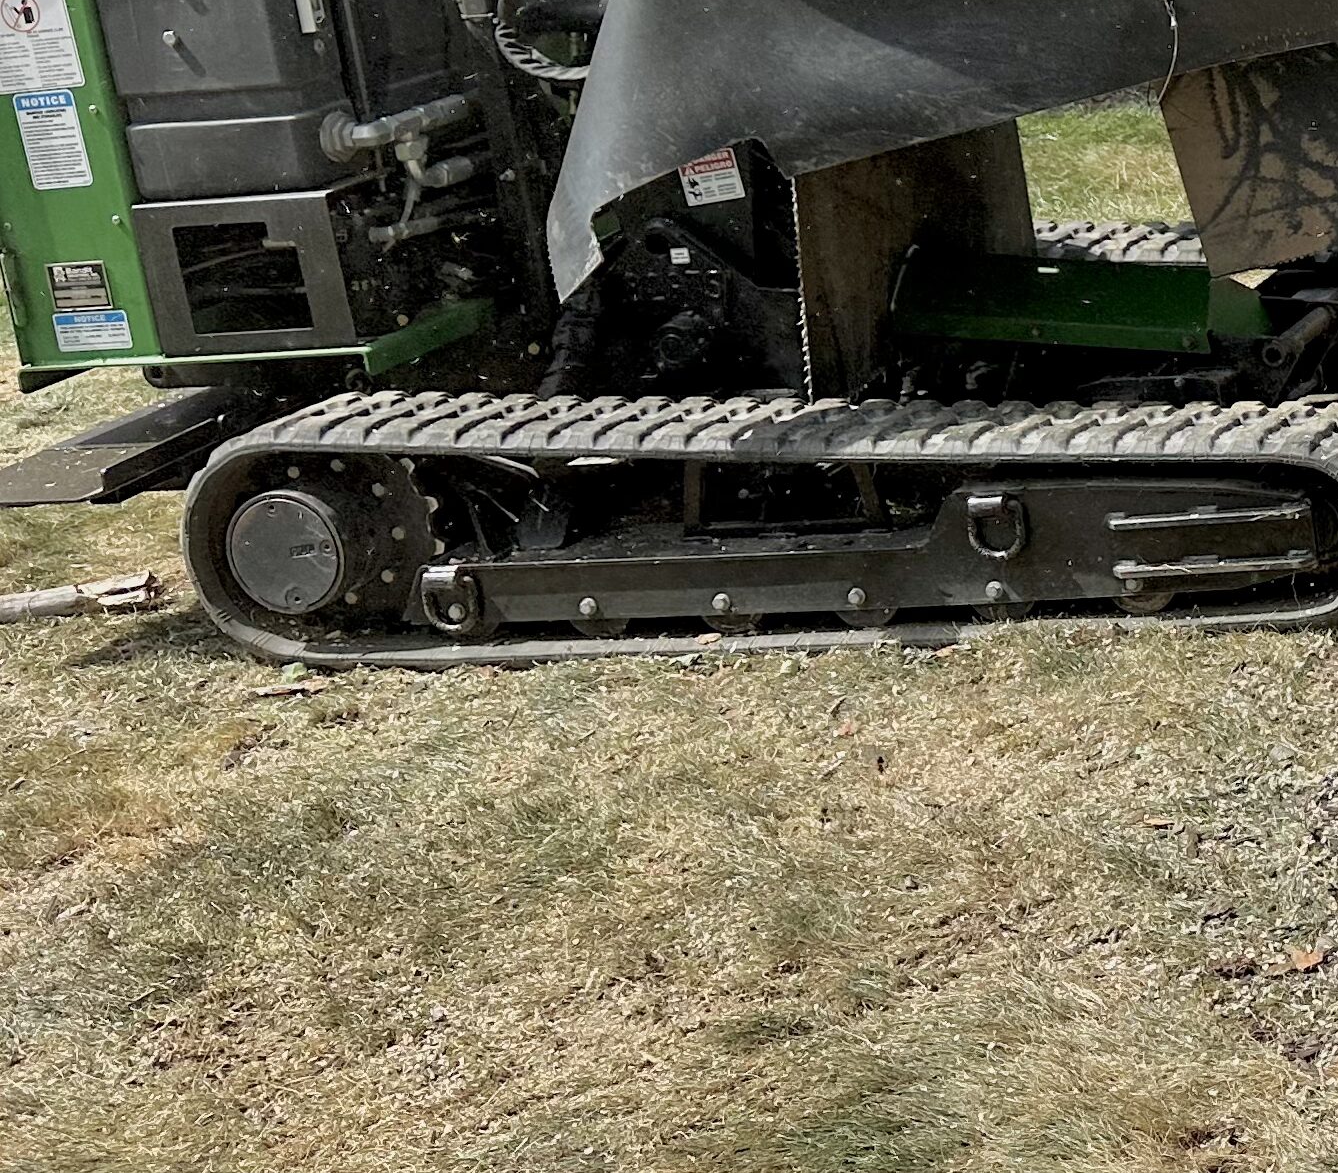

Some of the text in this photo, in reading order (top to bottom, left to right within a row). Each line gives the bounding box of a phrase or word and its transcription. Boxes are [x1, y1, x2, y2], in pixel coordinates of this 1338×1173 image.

[20, 95, 67, 107] NOTICE
[694, 160, 733, 173] PELIGRO
[73, 314, 106, 323] NOTICE
